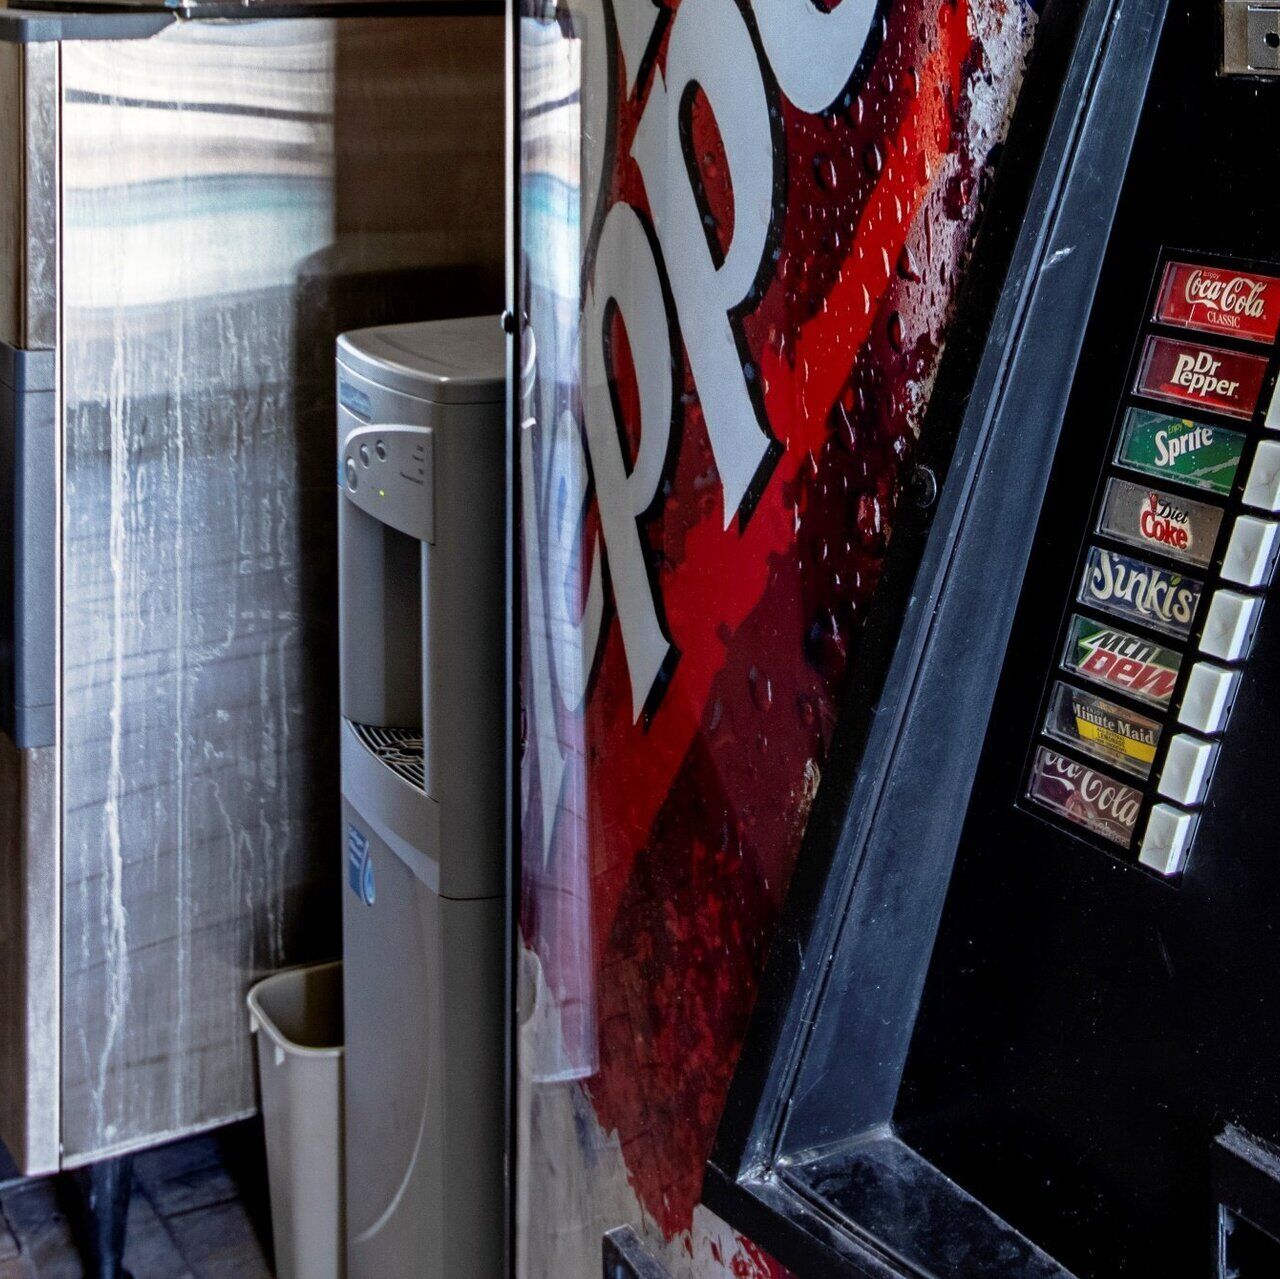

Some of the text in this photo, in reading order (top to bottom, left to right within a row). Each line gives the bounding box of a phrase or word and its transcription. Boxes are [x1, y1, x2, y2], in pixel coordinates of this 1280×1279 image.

[1206, 310, 1241, 328] CLASSIC
[1170, 353, 1240, 397] Pepper
[1193, 351, 1222, 376] Dr
[1154, 426, 1214, 467] Sprite
[1141, 510, 1188, 550] Coke
[1157, 499, 1189, 524] Diet
[1090, 551, 1200, 624] Sunkis
[1072, 701, 1115, 731] Minute
[1117, 720, 1154, 745] Maid
